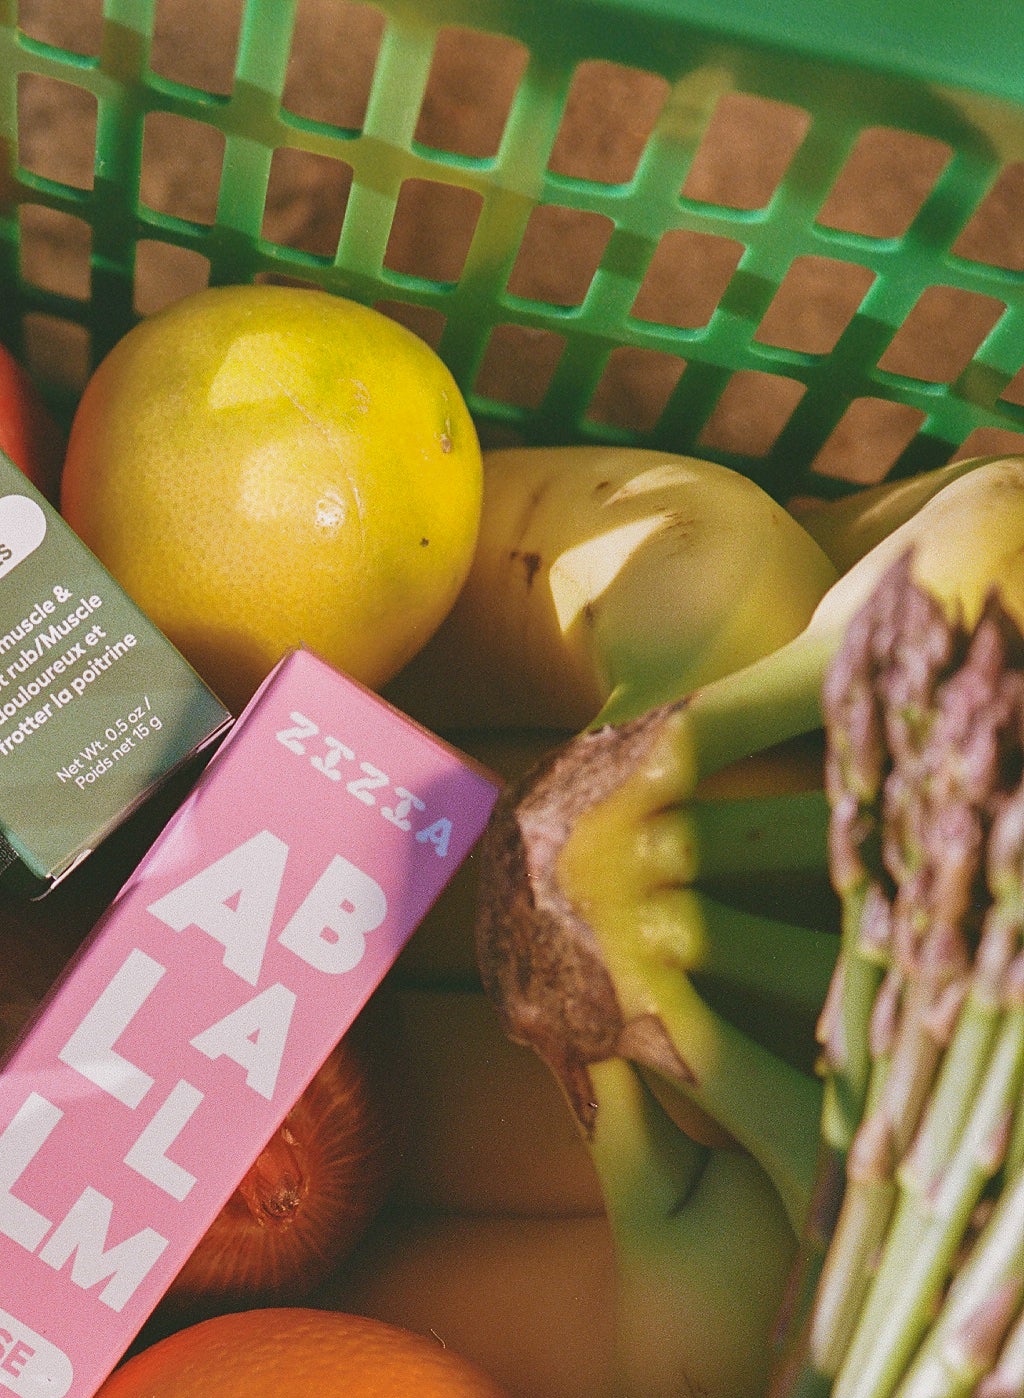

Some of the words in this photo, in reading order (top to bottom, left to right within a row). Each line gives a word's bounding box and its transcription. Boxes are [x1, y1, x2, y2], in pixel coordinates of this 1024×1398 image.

[53, 586, 72, 602] &
[50, 689, 73, 708] la
[71, 634, 137, 695] poitrine
[85, 625, 106, 645] et
[57, 759, 84, 782] Net
[80, 741, 108, 760] Wt.
[105, 719, 128, 741] 0.5
[128, 707, 145, 723] oz
[75, 758, 113, 789] Poids
[112, 738, 135, 760] net
[133, 723, 149, 739] 15
[150, 716, 162, 730] g
[276, 711, 455, 857] ZIZIA
